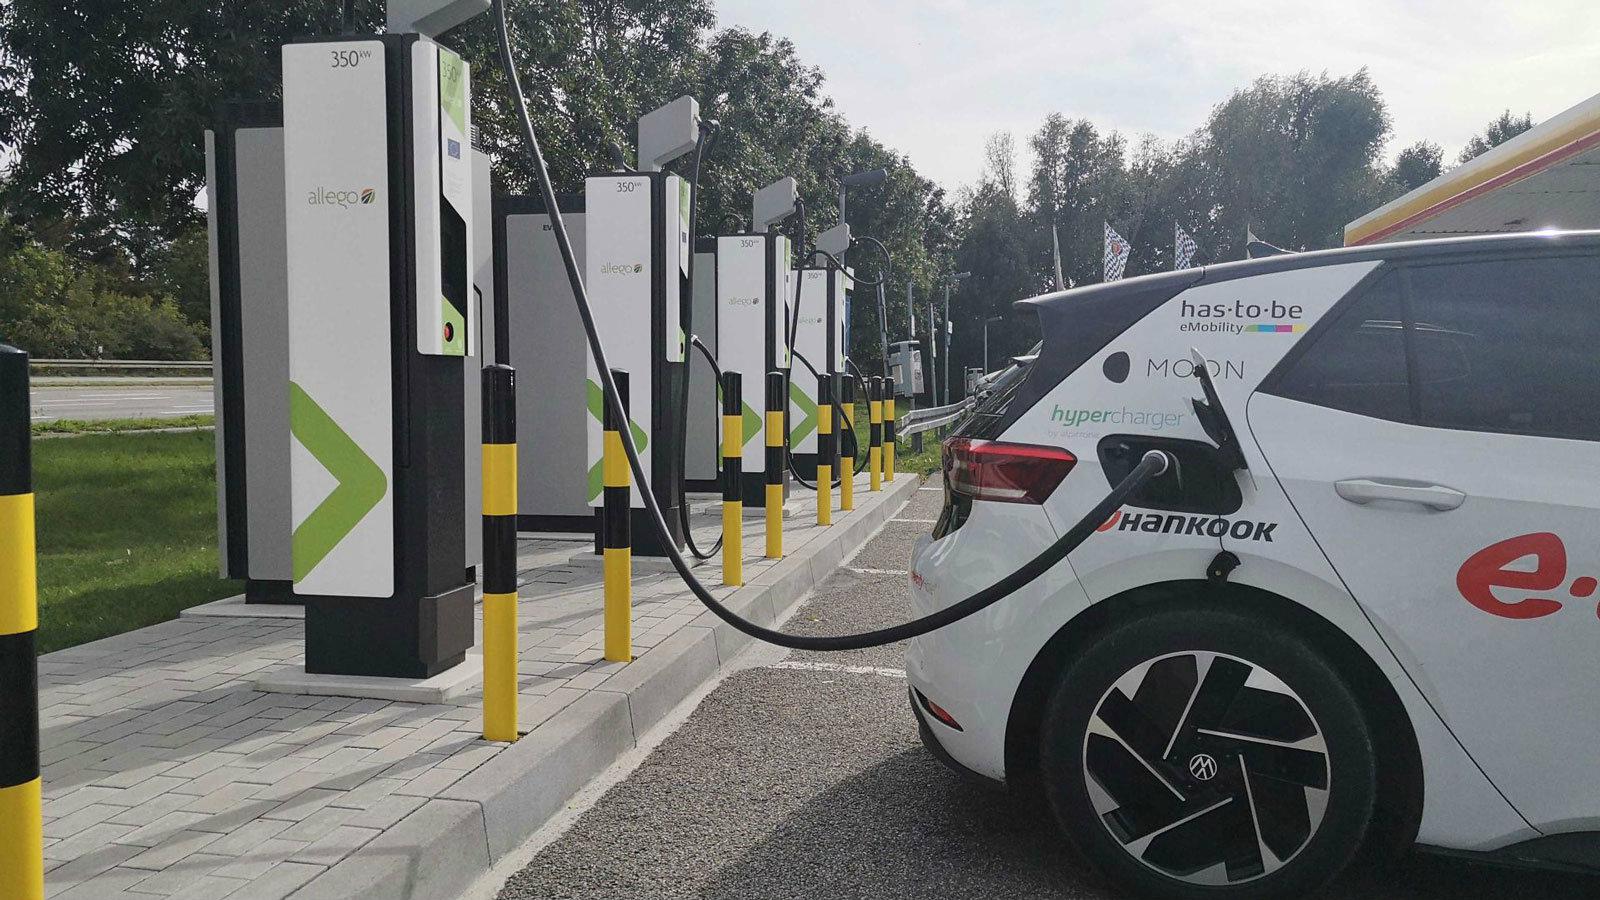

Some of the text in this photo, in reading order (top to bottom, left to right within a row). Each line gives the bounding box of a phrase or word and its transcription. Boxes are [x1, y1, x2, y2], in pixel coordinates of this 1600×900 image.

[308, 187, 359, 209] allego
[601, 262, 632, 275] allego
[1180, 322, 1243, 335] eMobility
[1051, 404, 1185, 430] hypercharger
